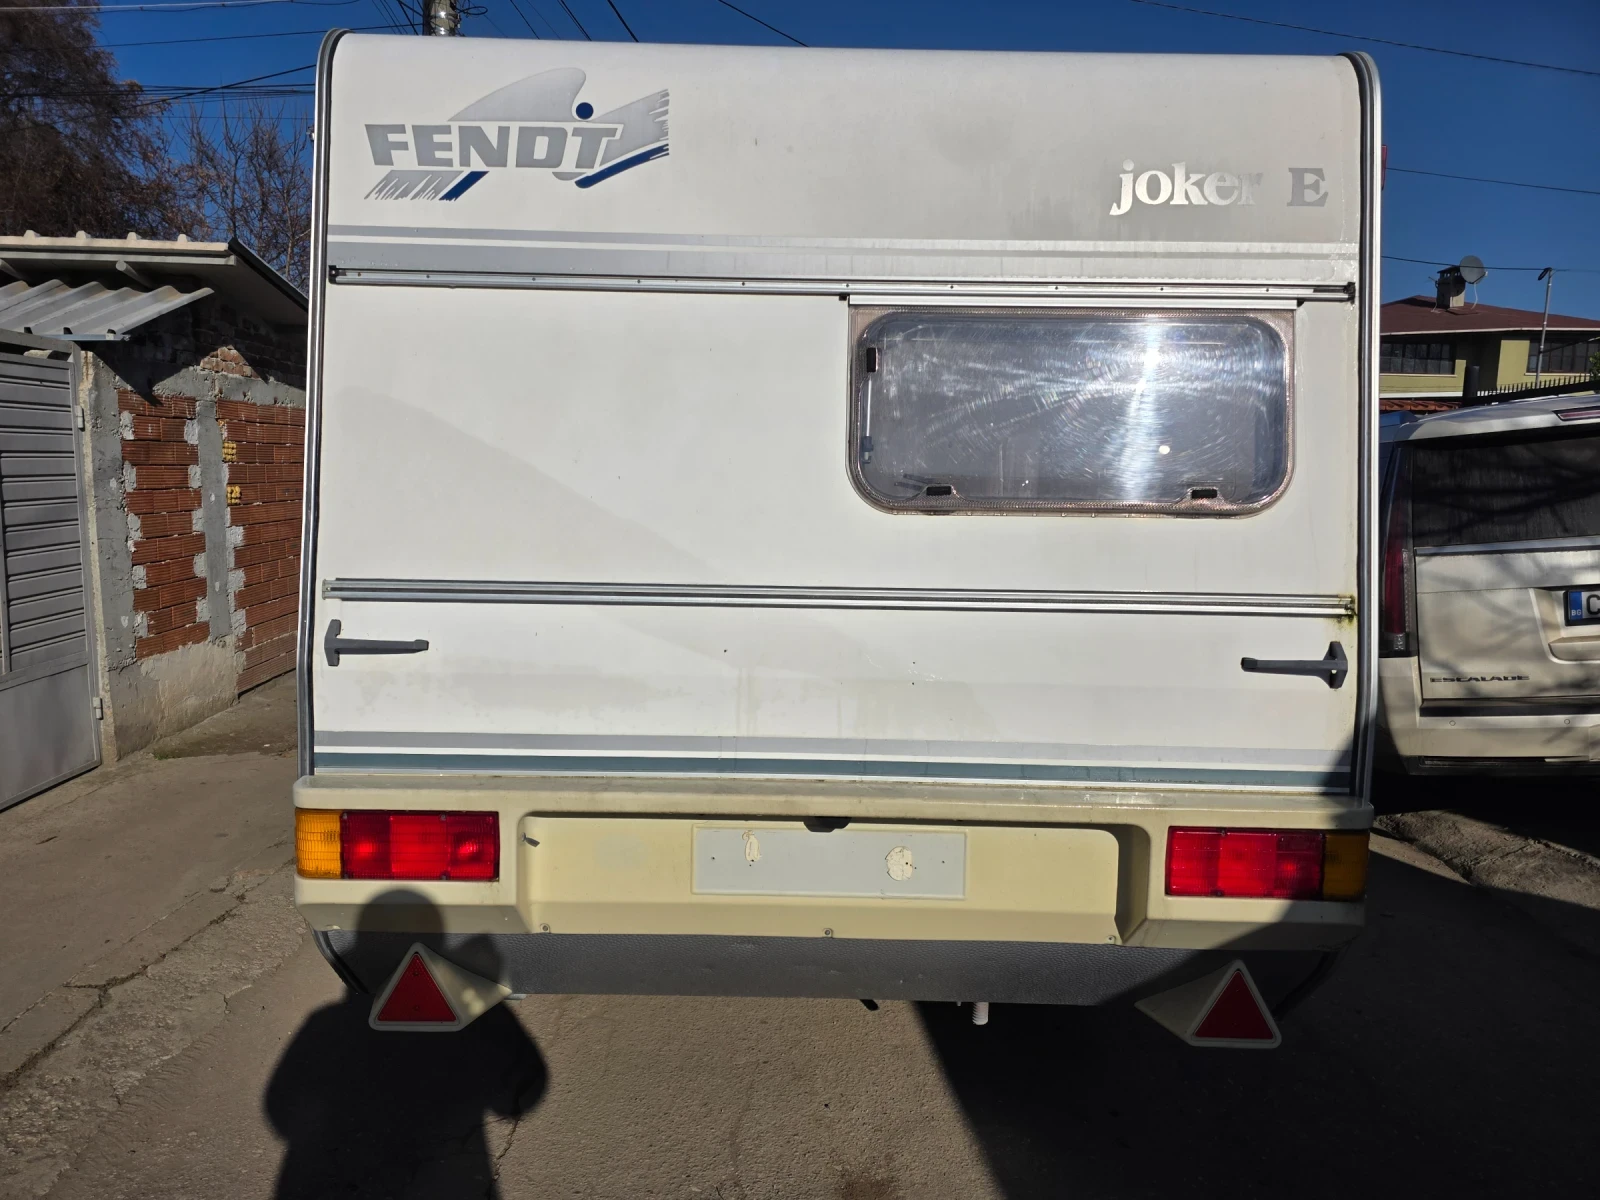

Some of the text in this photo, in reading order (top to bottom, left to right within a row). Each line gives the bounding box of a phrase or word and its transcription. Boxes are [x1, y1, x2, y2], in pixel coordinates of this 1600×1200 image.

[364, 124, 619, 170] FENDT
[1109, 159, 1329, 216] joker E
[1429, 675, 1530, 683] ESCALADE
